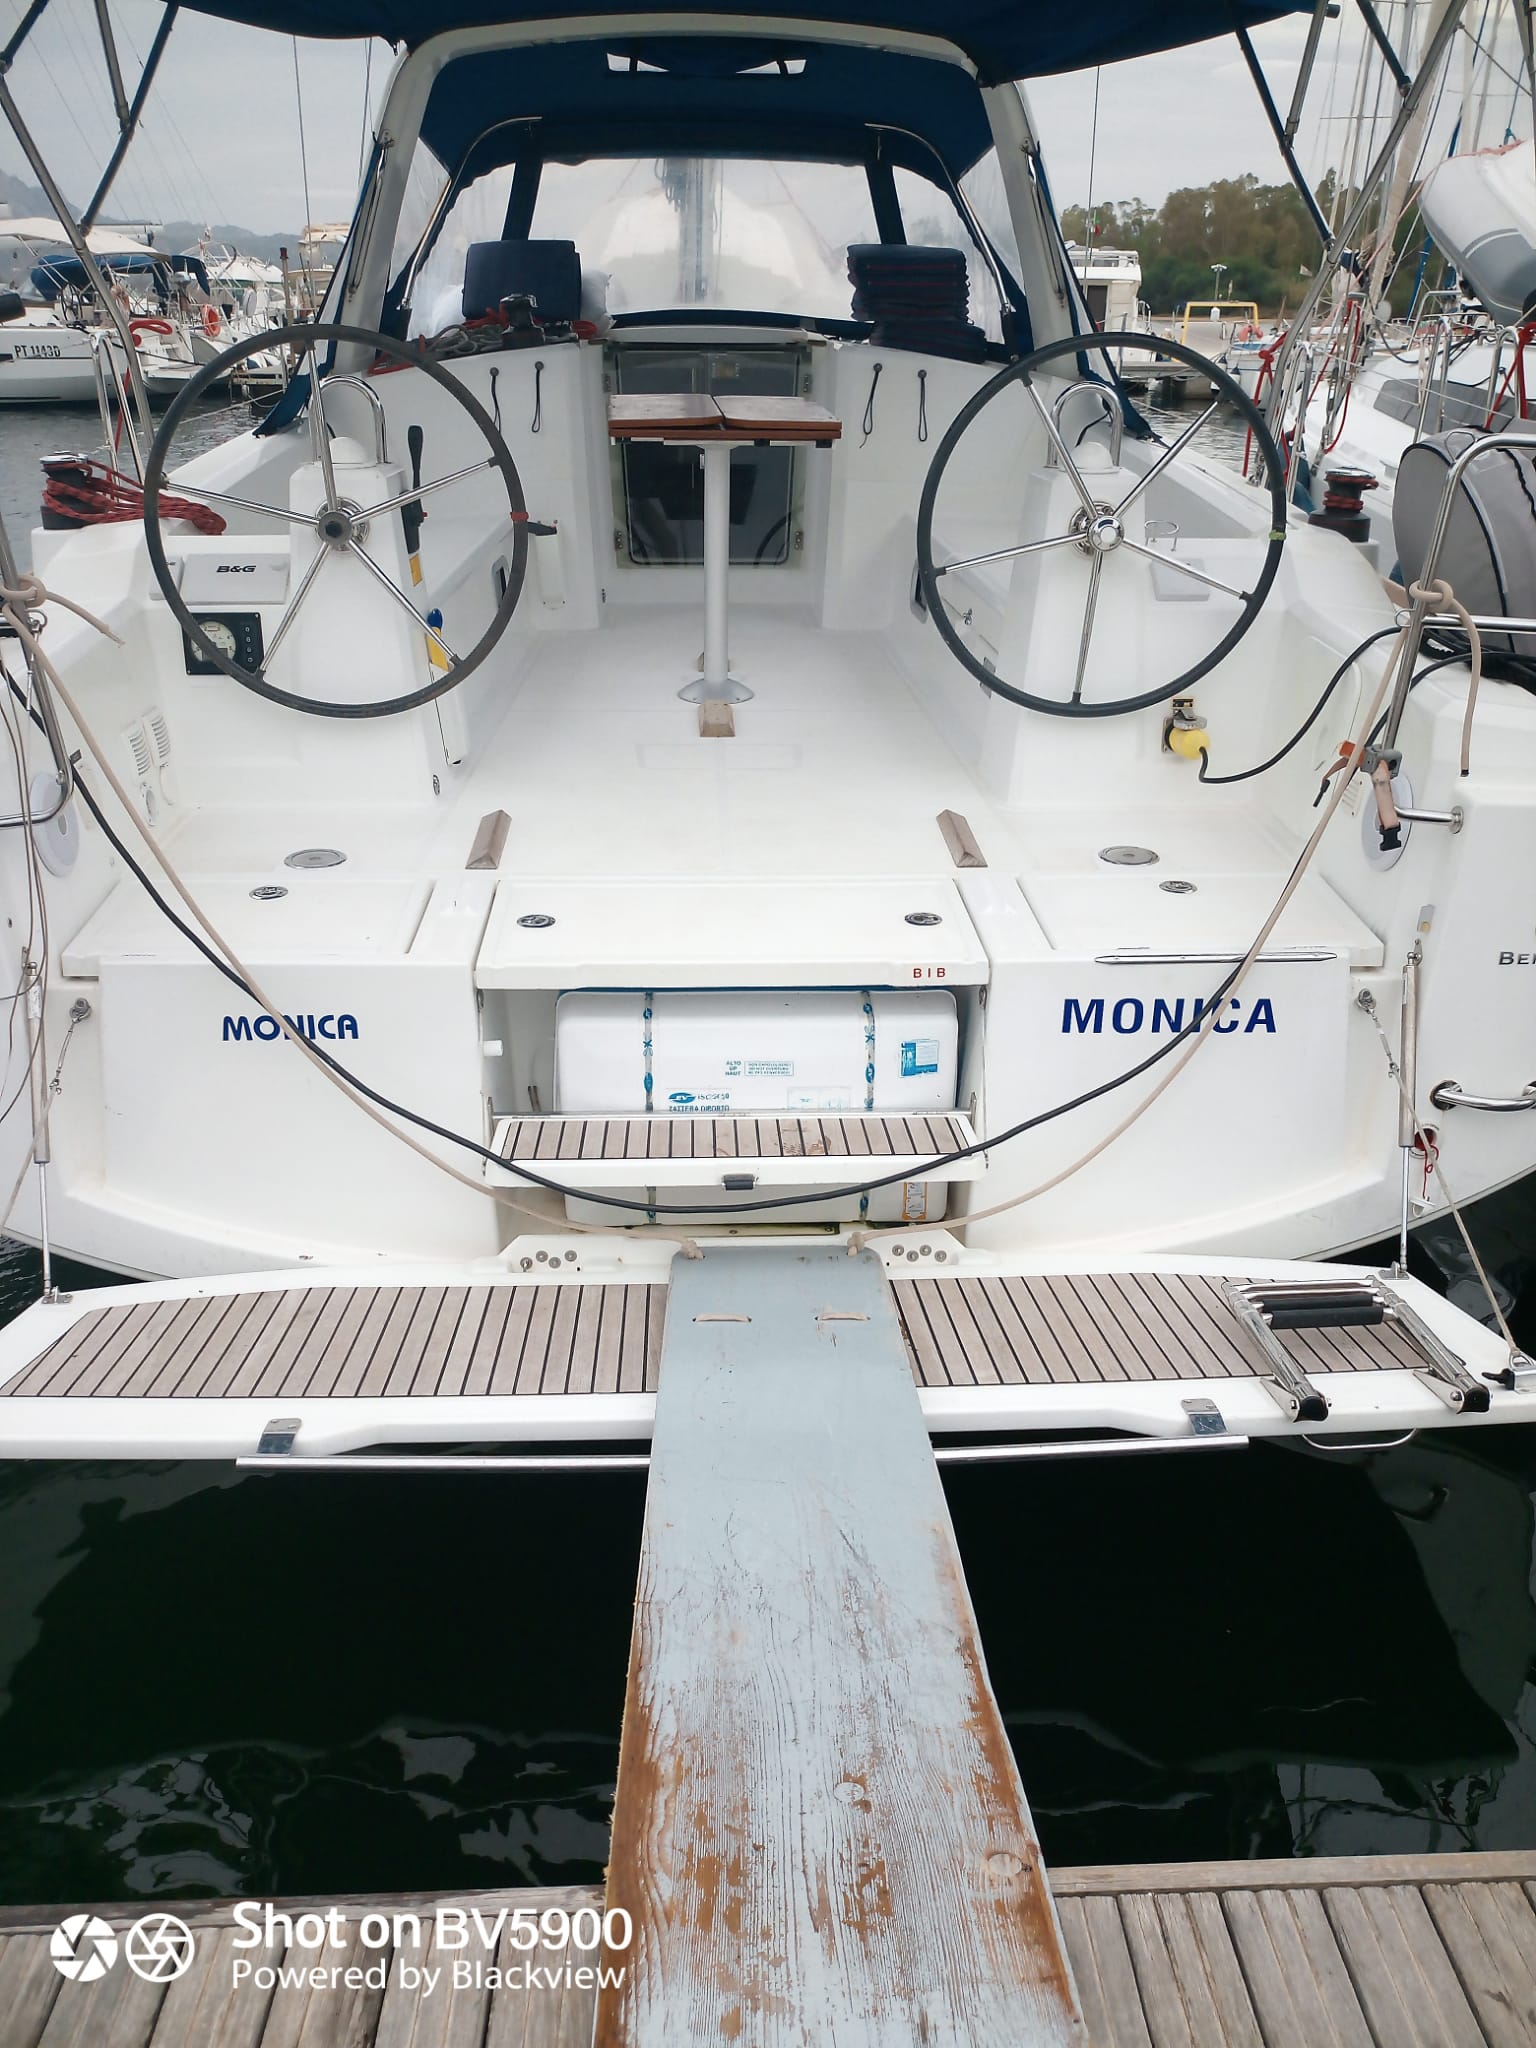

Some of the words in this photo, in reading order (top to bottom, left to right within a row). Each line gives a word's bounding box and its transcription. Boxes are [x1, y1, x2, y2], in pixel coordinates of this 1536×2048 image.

[14, 345, 27, 357] PT
[216, 565, 257, 573] B&G
[1499, 951, 1536, 965] BE
[913, 967, 946, 978] BIB
[1061, 997, 1277, 1034] MONICA
[223, 1014, 359, 1041] MONICA
